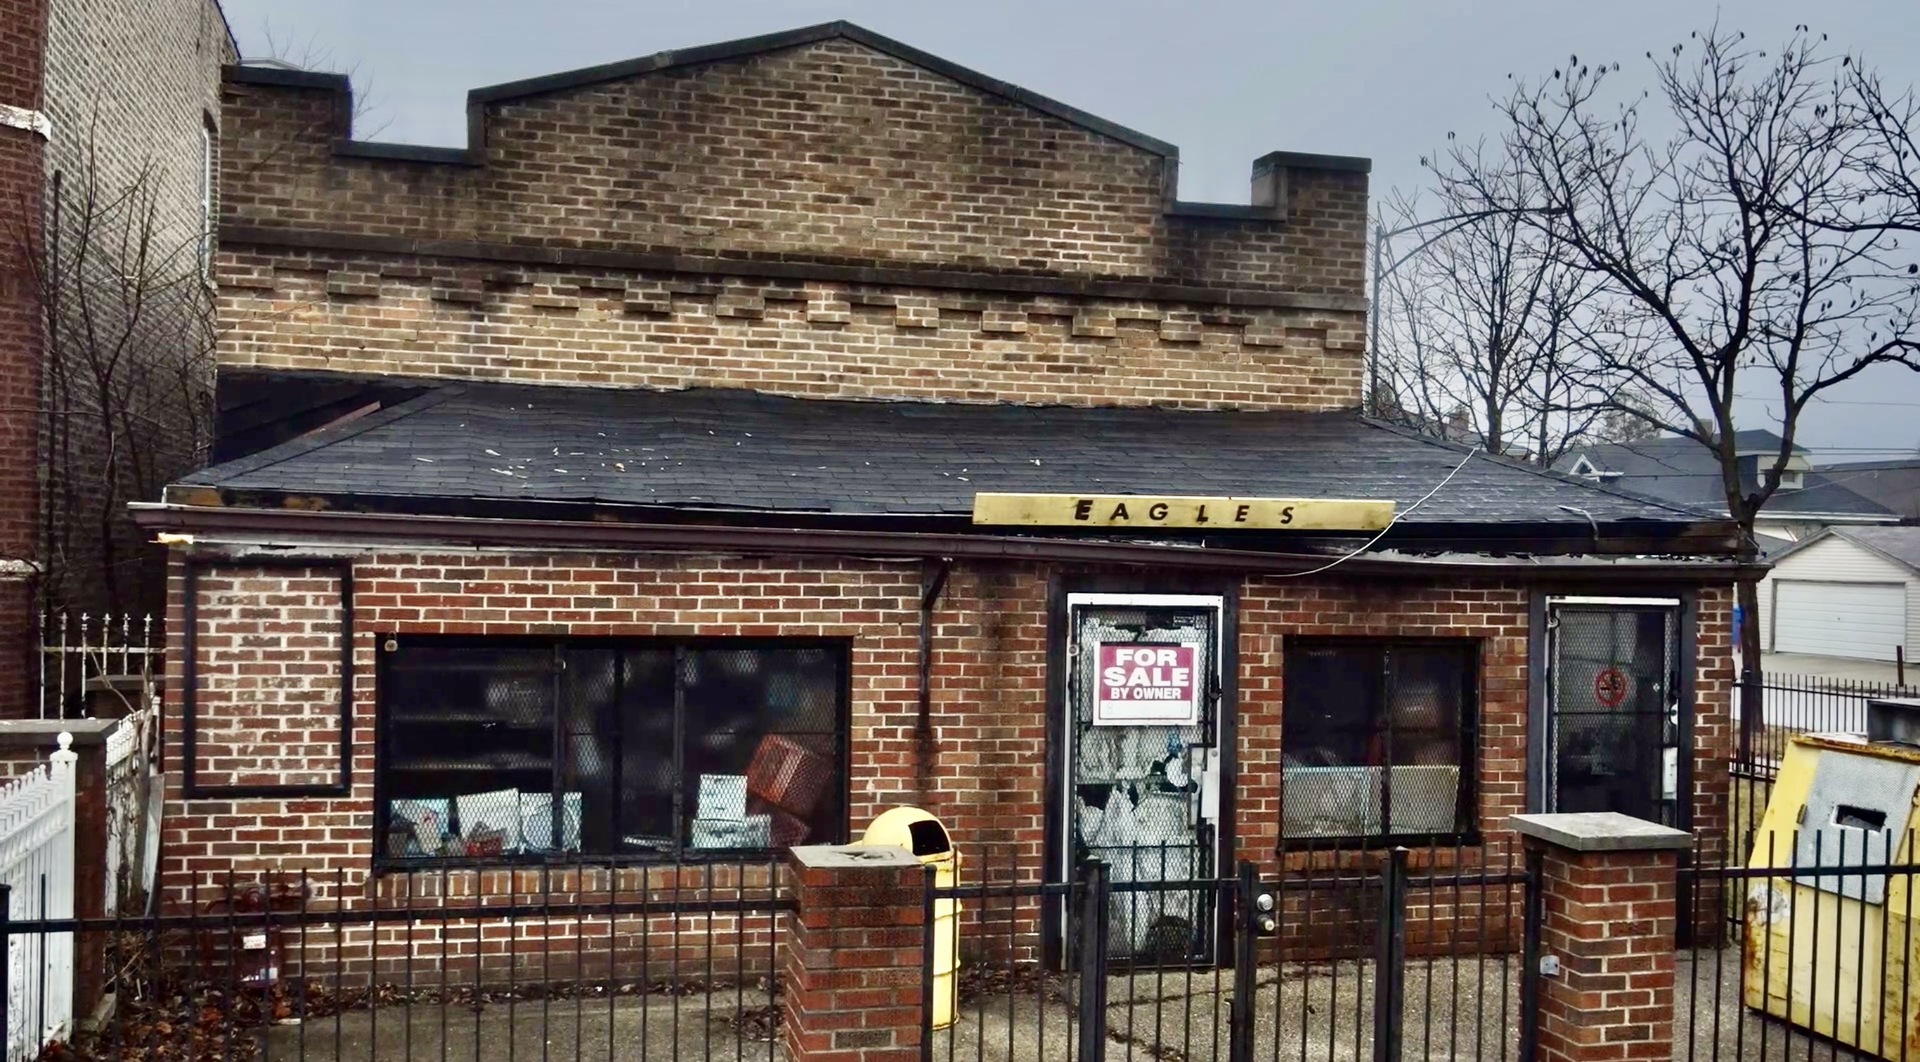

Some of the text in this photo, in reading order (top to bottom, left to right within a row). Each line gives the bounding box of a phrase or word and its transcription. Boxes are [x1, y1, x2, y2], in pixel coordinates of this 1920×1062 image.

[1074, 500, 1294, 524] EAGLES
[1116, 649, 1178, 666] FOR
[1103, 667, 1189, 687] SALE
[1111, 688, 1181, 699] BY OWNER
